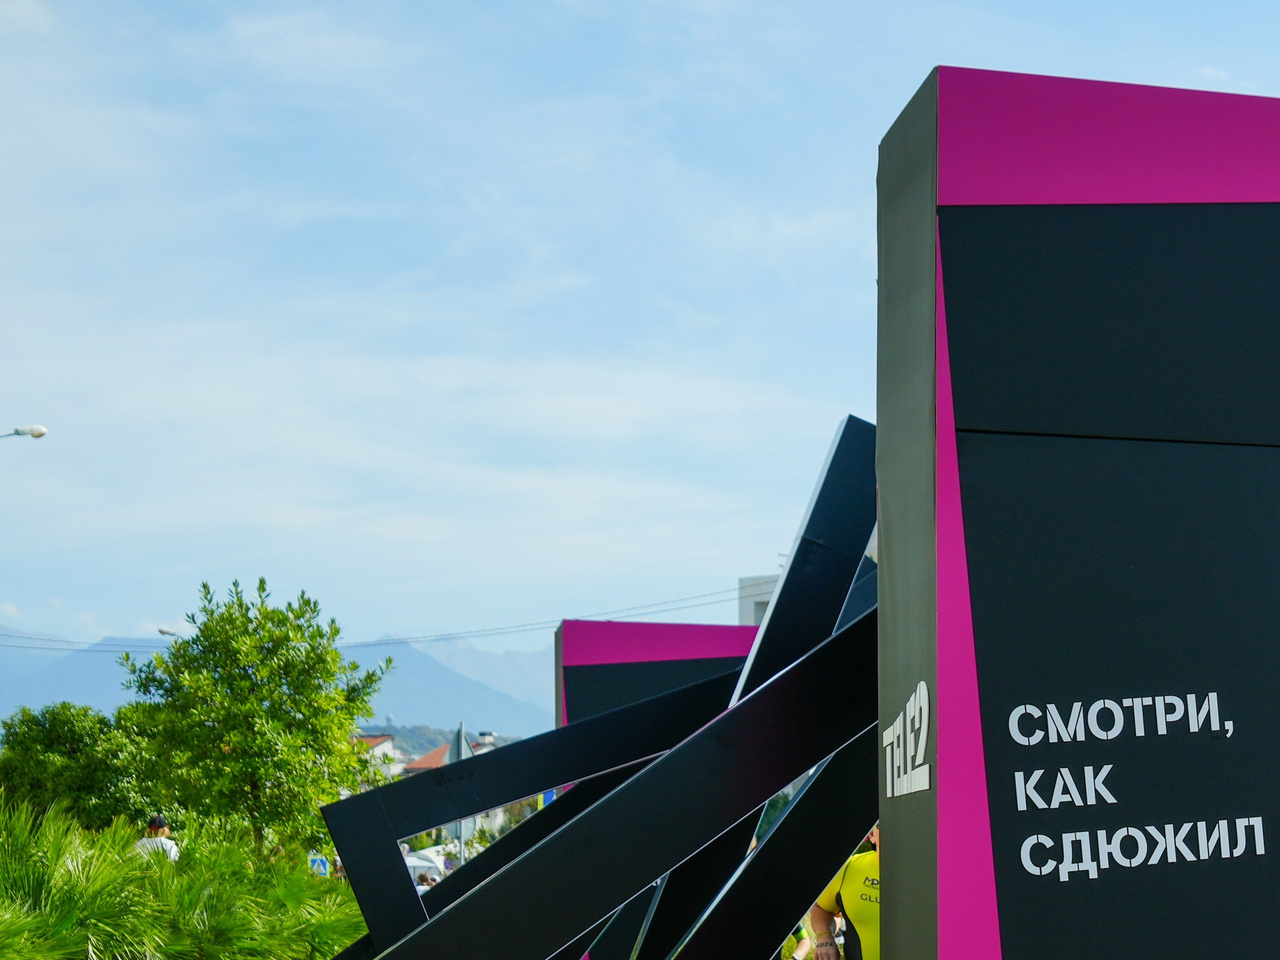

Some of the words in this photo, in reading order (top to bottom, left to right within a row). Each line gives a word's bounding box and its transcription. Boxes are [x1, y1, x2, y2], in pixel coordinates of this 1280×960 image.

[882, 680, 930, 798] TELE2
[1008, 691, 1234, 746] СМОТРИ,
[1014, 764, 1118, 812] КАК
[1020, 816, 1266, 882] СДЮЖИЛ
